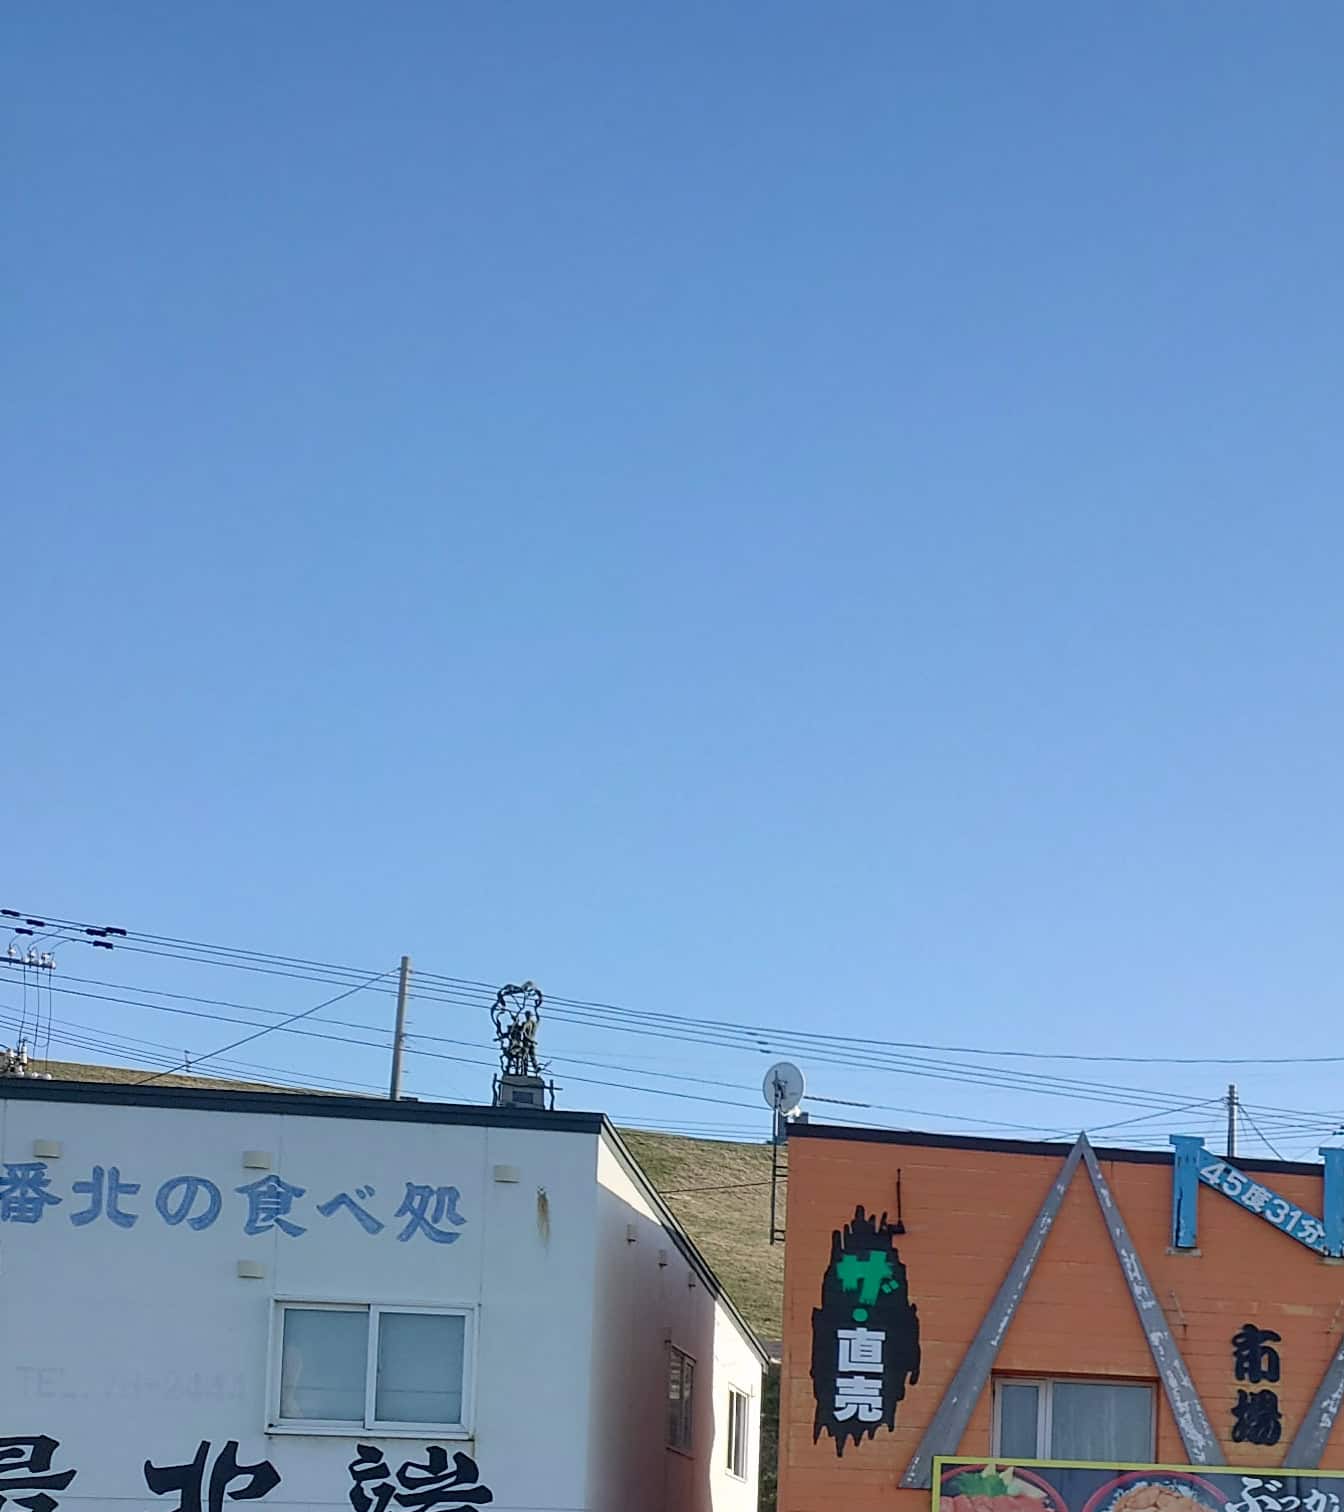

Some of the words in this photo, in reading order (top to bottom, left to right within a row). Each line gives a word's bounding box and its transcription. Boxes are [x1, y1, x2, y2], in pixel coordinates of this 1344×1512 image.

[0, 1162, 467, 1244] 番北の食べ処
[1199, 1162, 1326, 1244] 45度31分
[1231, 1323, 1283, 1447] 市場
